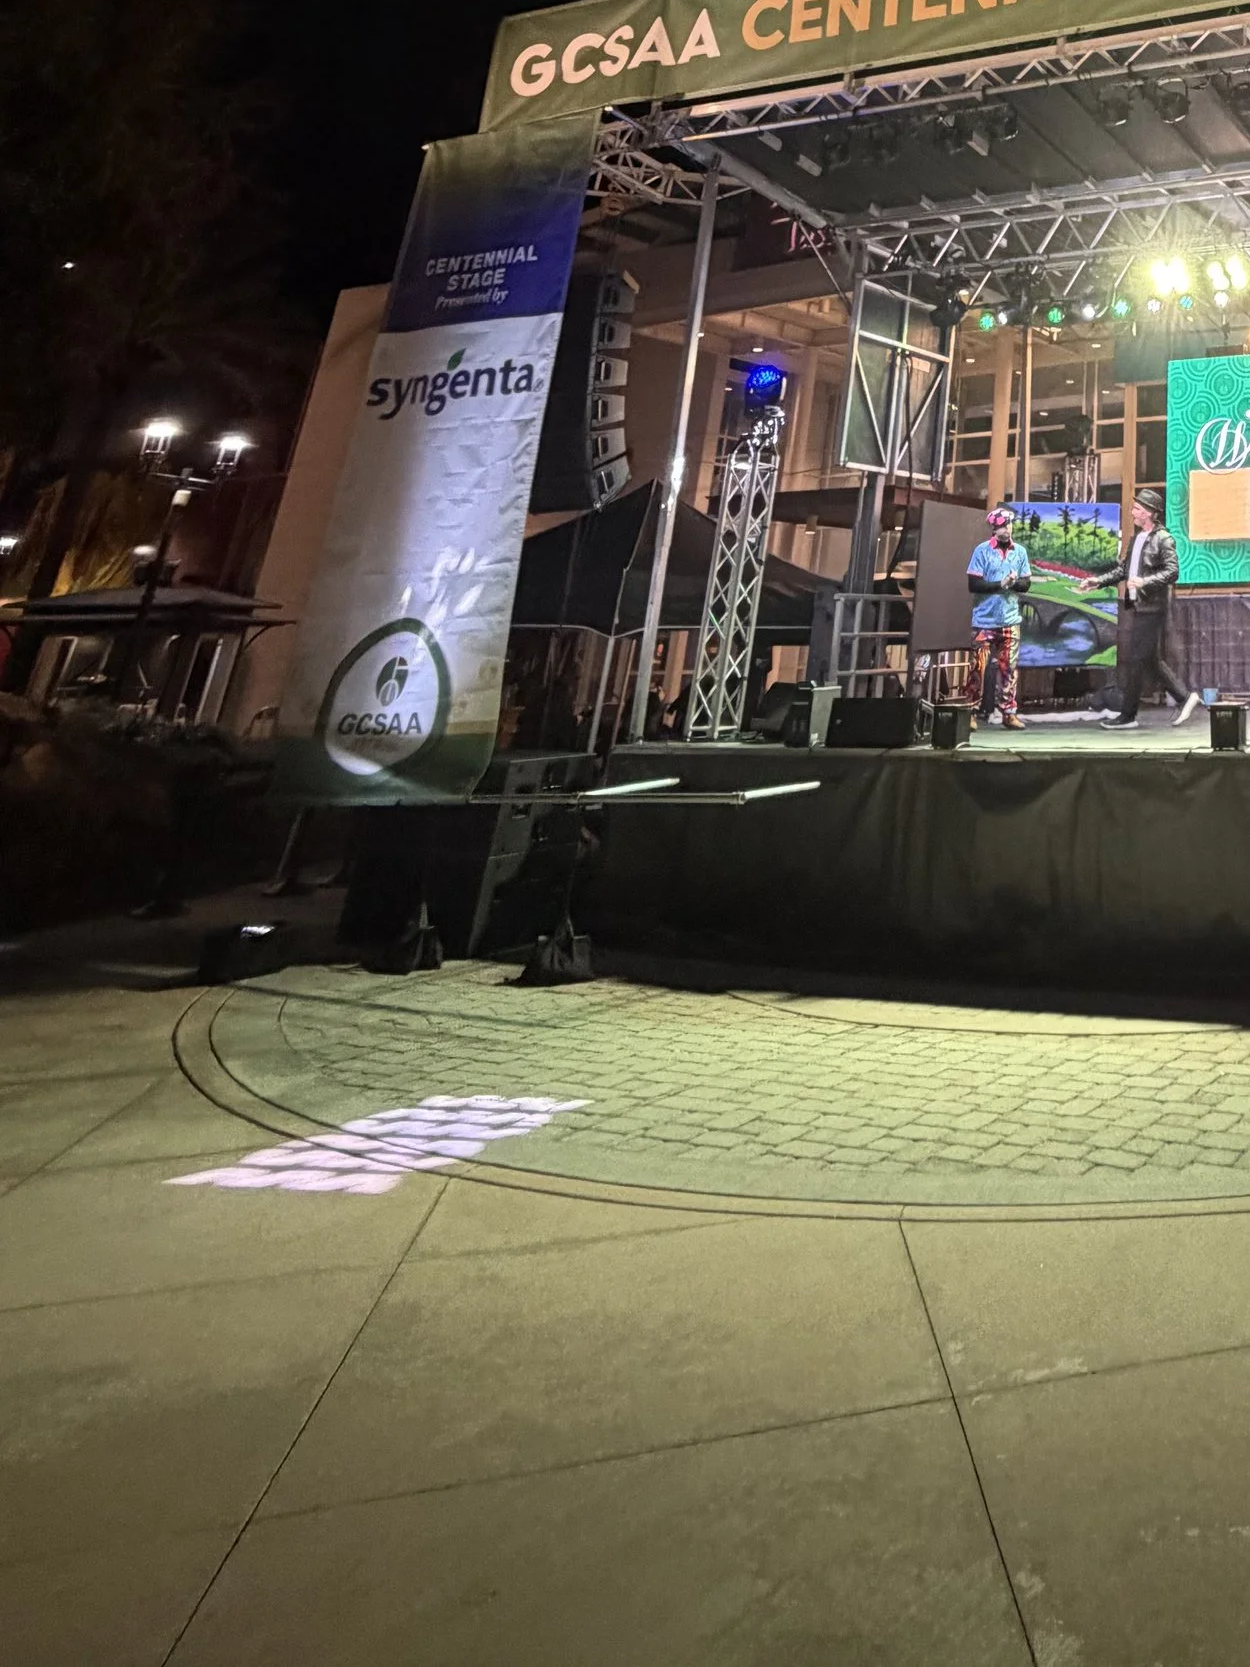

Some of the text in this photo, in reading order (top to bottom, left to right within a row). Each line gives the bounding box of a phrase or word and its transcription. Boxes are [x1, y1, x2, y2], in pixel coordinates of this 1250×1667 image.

[510, 8, 720, 97] GCSAA
[425, 245, 538, 277] CENTENNIAL
[447, 269, 506, 291] STAGE
[435, 288, 508, 310] Presented by
[337, 712, 422, 734] GCSAA
